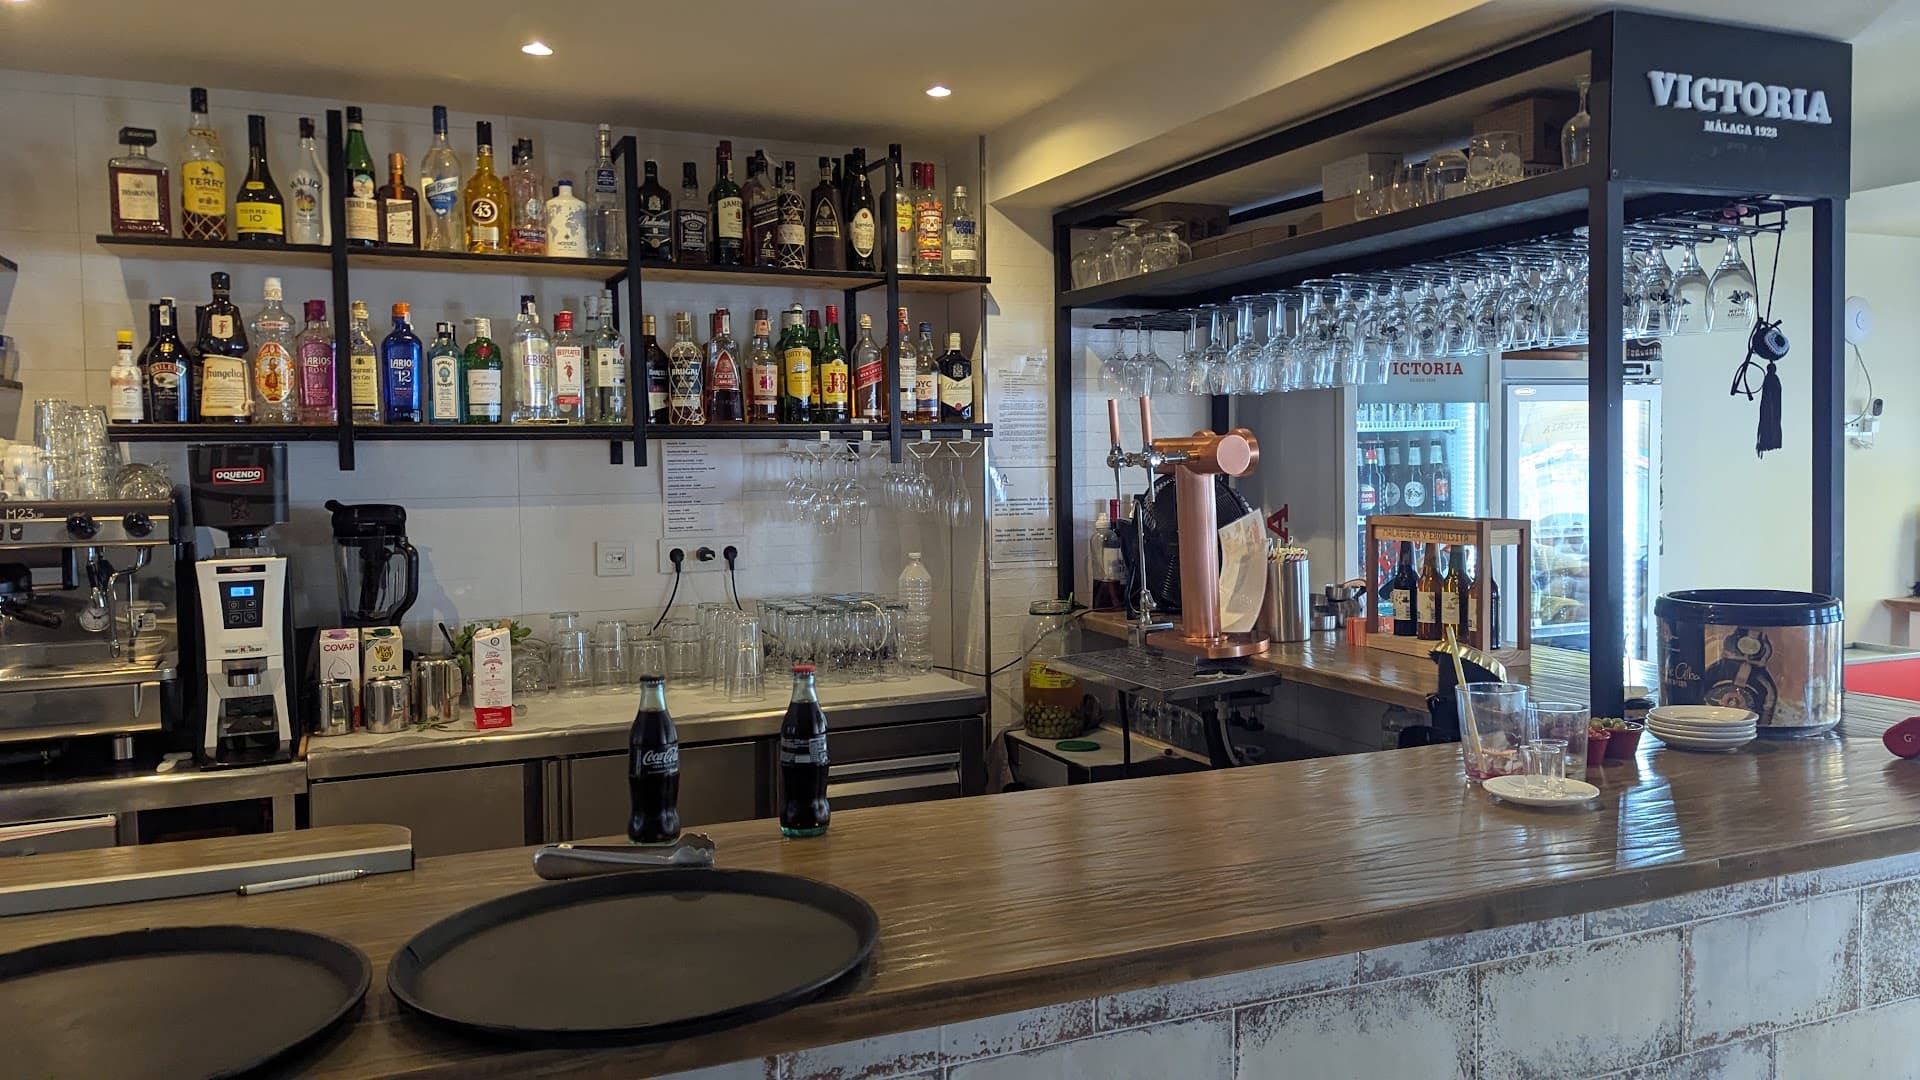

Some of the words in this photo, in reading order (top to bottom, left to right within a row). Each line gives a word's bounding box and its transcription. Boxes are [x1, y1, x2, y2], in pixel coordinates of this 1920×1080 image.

[1648, 70, 1832, 124] VICTORIA
[1704, 119, 1752, 136] MÁLAGA
[1754, 125, 1778, 138] 1928
[189, 177, 224, 189] TERRY
[473, 202, 492, 218] 43
[304, 356, 331, 368] LARIOS
[1380, 362, 1464, 376] ICTORIA
[398, 369, 412, 383] 12
[216, 470, 261, 482] OQUENDO
[323, 643, 355, 652] COVAP
[372, 664, 398, 673] SOJA
